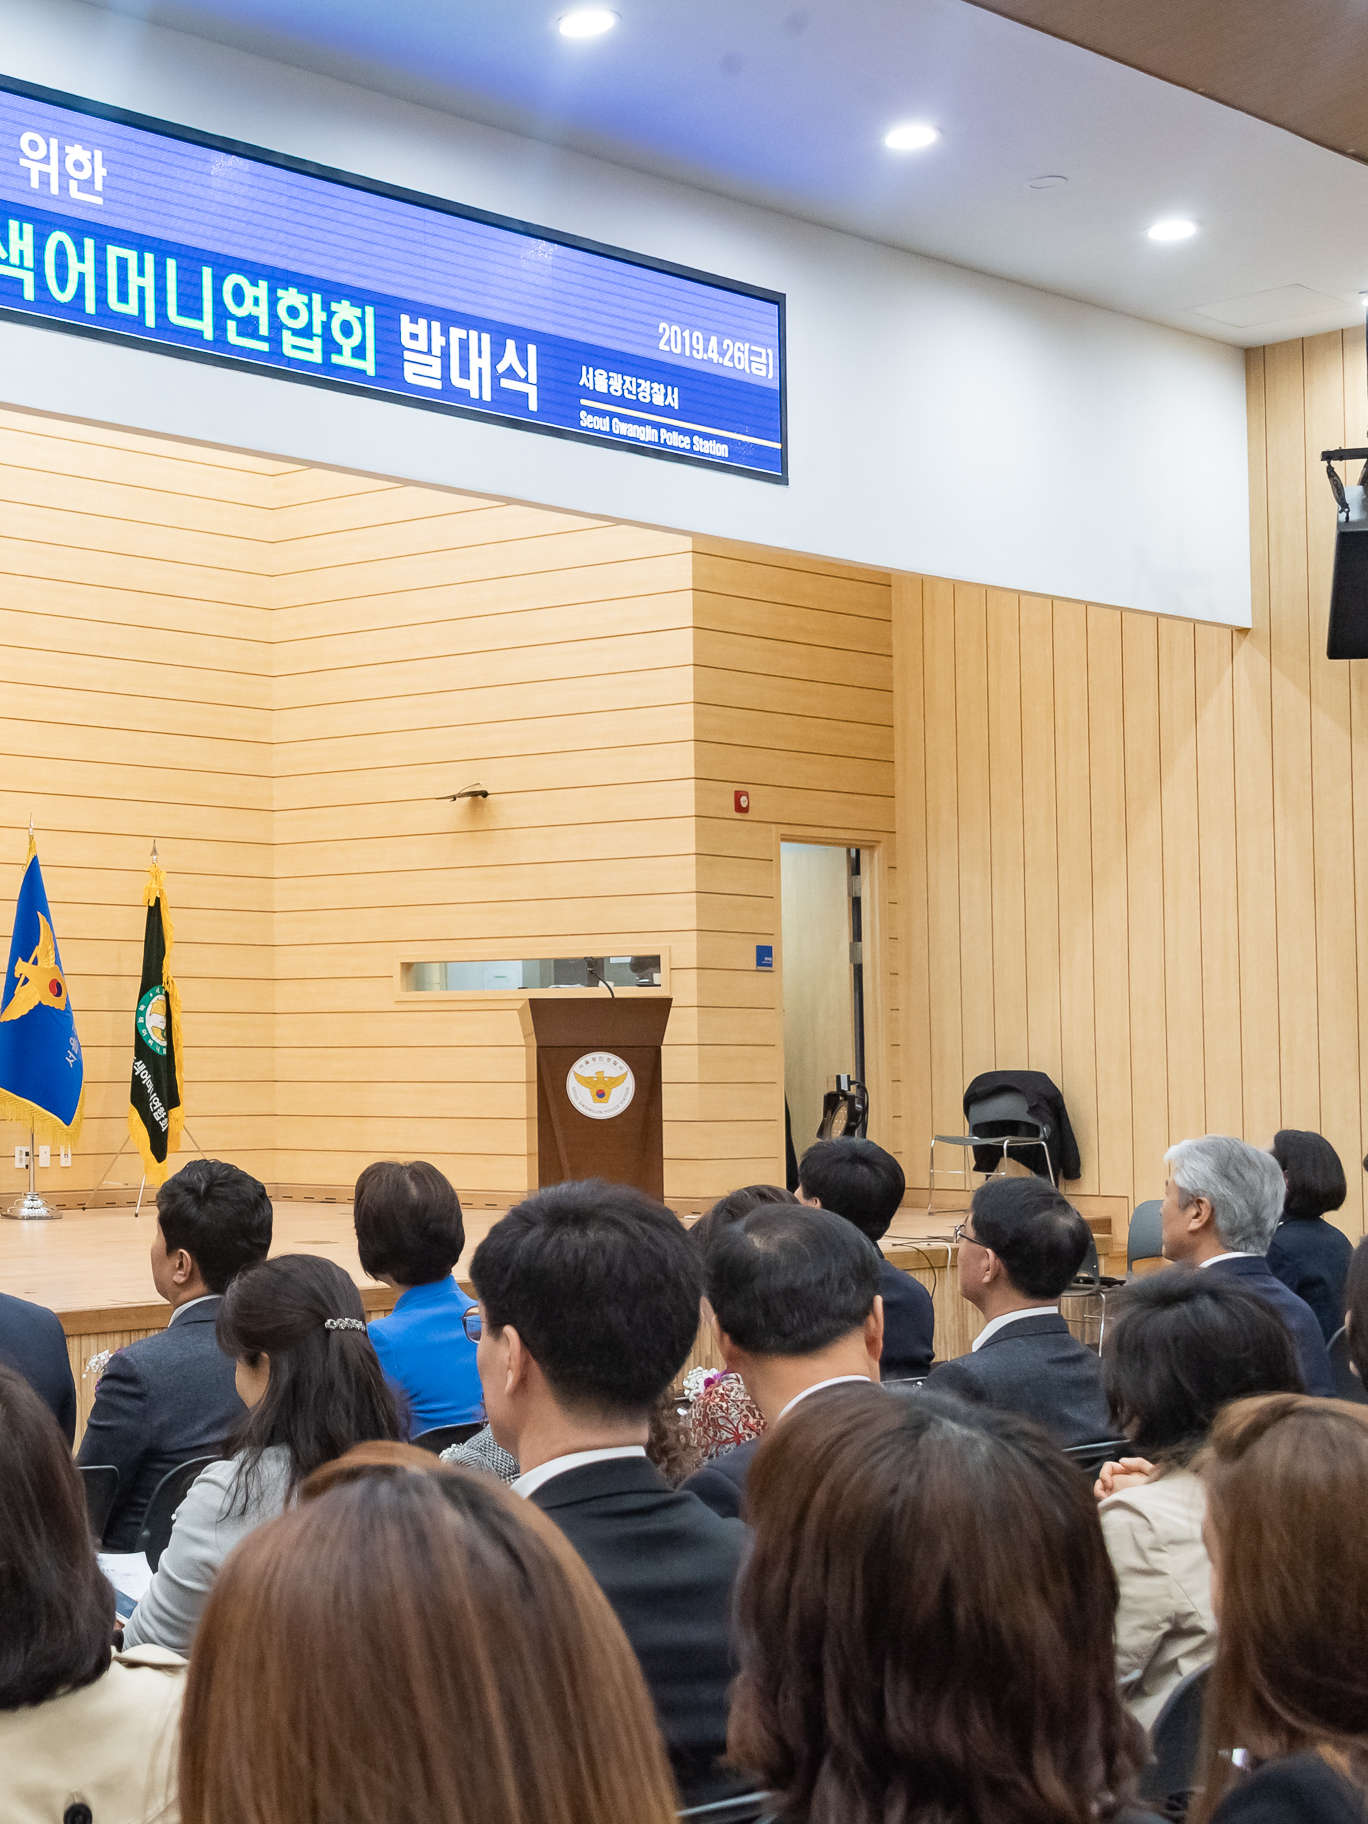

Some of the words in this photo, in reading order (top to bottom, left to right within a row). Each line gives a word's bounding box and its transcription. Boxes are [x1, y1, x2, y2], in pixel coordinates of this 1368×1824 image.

[19, 131, 107, 205] 위한
[400, 312, 538, 413] 발대식
[658, 322, 774, 380] 2019.4.26(금)
[578, 365, 679, 411] 서울광진경찰서
[580, 410, 610, 432] Seoul
[612, 417, 659, 443] Gwangjin
[660, 428, 691, 451] Police
[692, 435, 729, 458] Station
